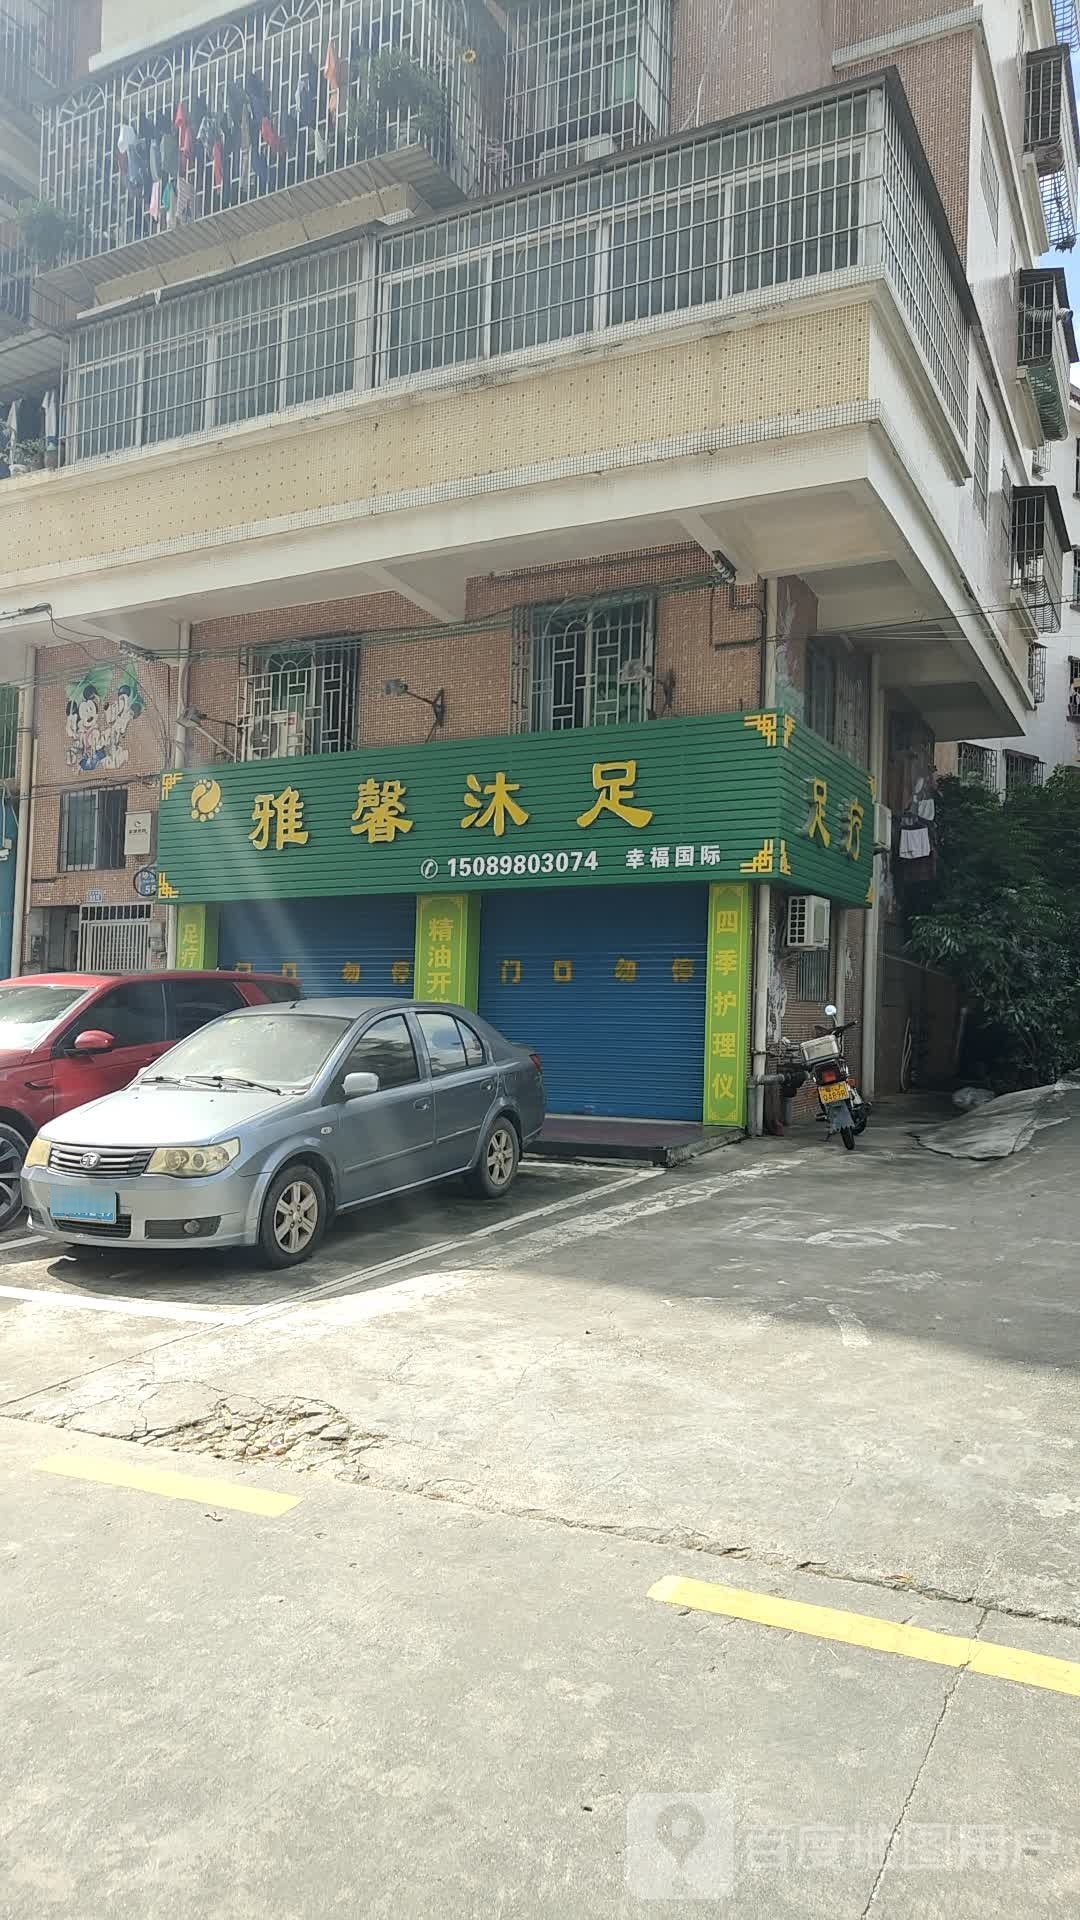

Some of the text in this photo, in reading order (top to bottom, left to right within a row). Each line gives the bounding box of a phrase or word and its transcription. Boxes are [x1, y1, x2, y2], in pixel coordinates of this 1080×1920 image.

[248, 760, 653, 850] 雅馨沐足
[803, 777, 864, 860] 足疗
[447, 850, 598, 877] 15089803074
[625, 845, 720, 869] 幸福国际
[182, 924, 199, 968] 足疗
[427, 915, 454, 1003] 精油开
[712, 911, 737, 1099] 四季护理仪
